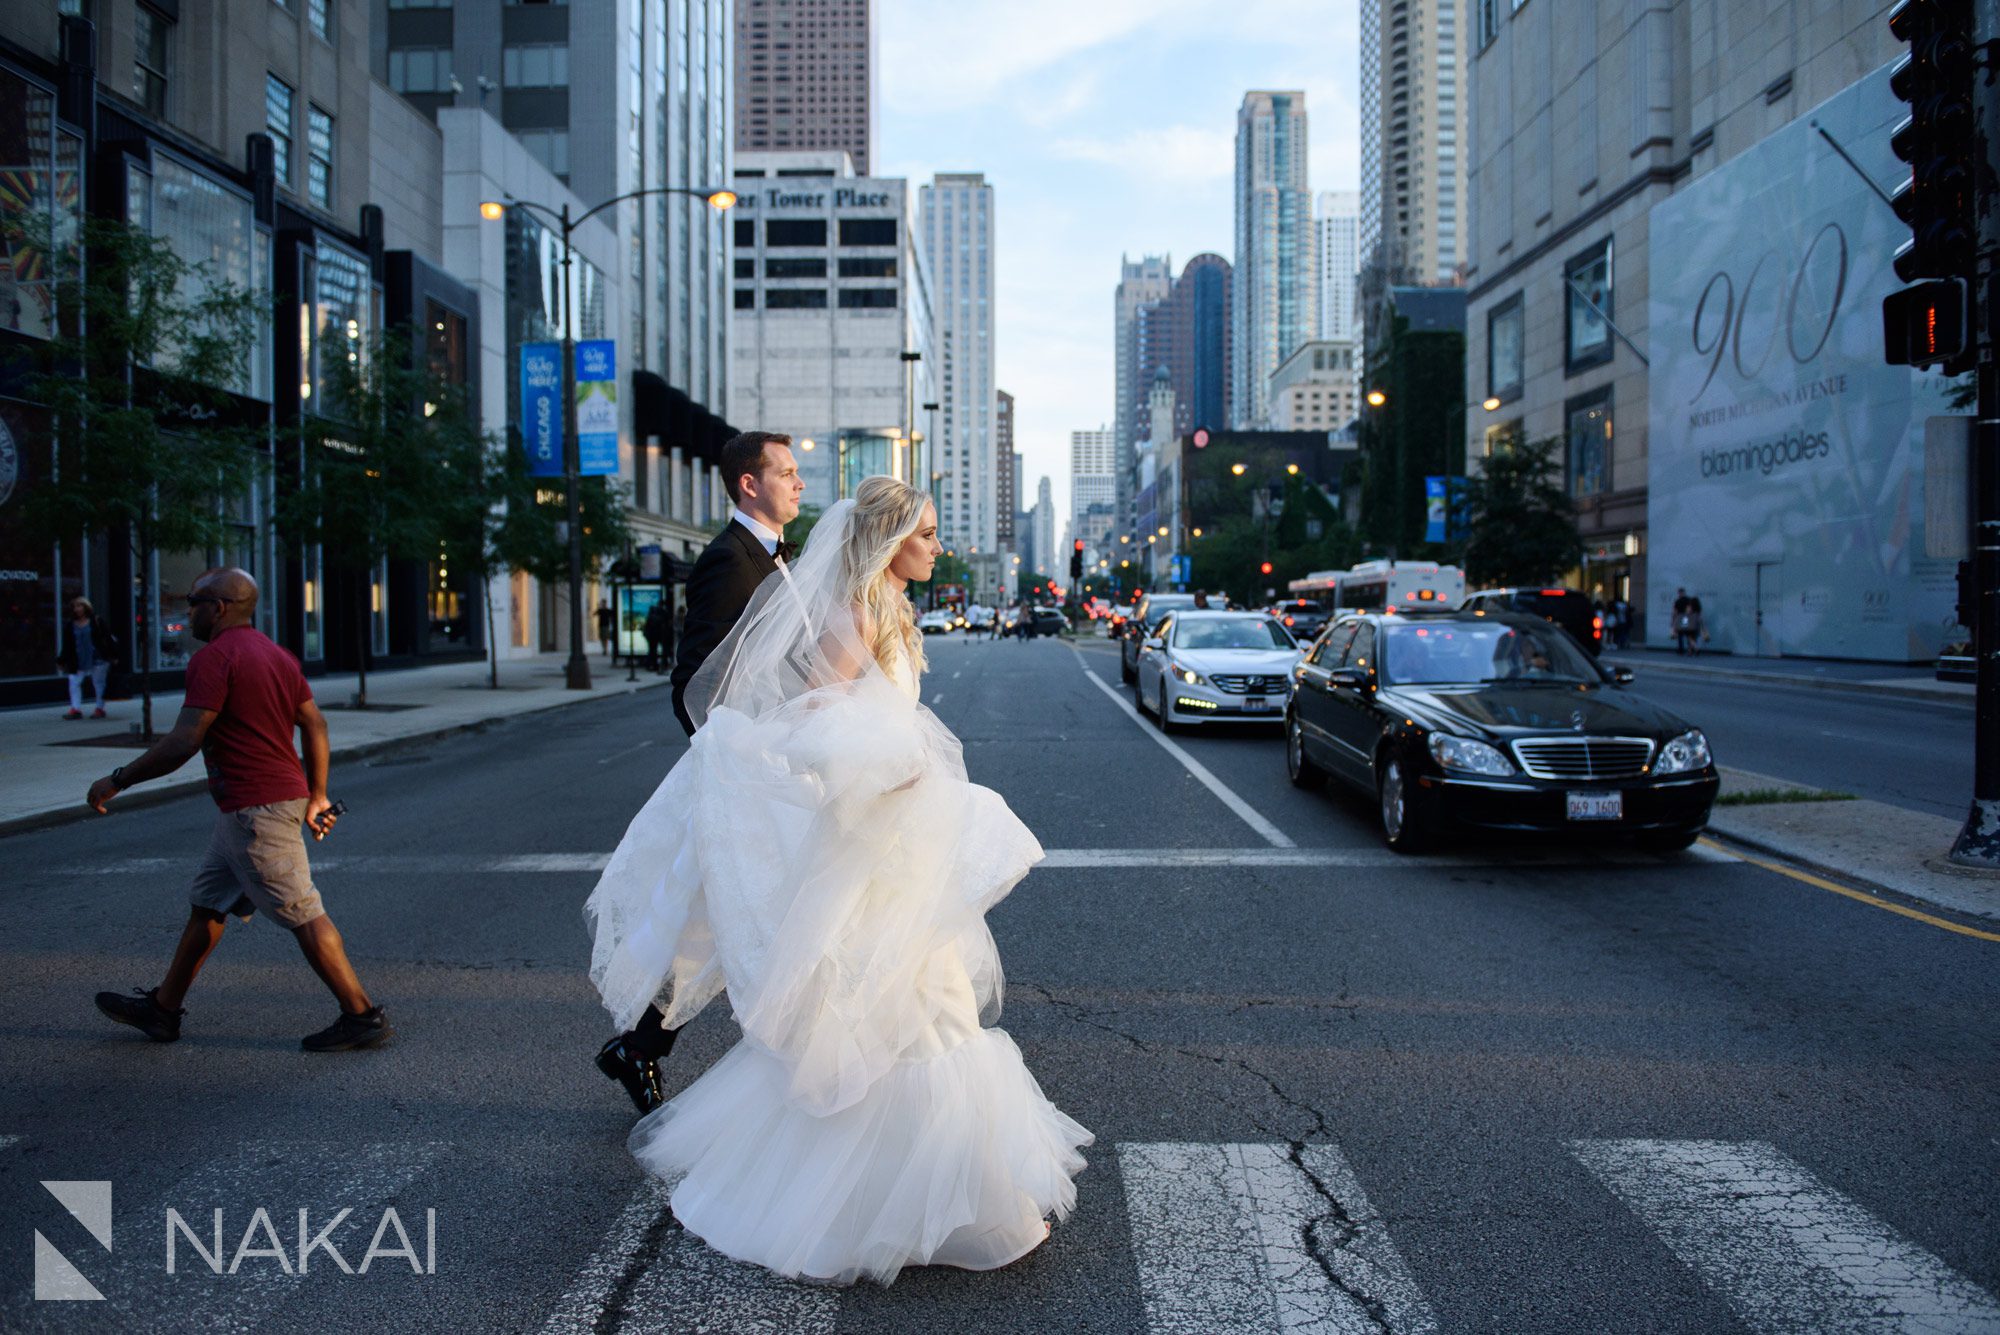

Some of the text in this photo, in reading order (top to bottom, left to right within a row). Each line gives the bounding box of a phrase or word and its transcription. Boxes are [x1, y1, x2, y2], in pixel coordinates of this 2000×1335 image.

[737, 188, 889, 208] er Tower Place
[1689, 222, 1848, 405] 900
[537, 396, 552, 460] CHICAGO
[1690, 407, 1726, 428] NORTH
[1794, 374, 1848, 403] AVENUE
